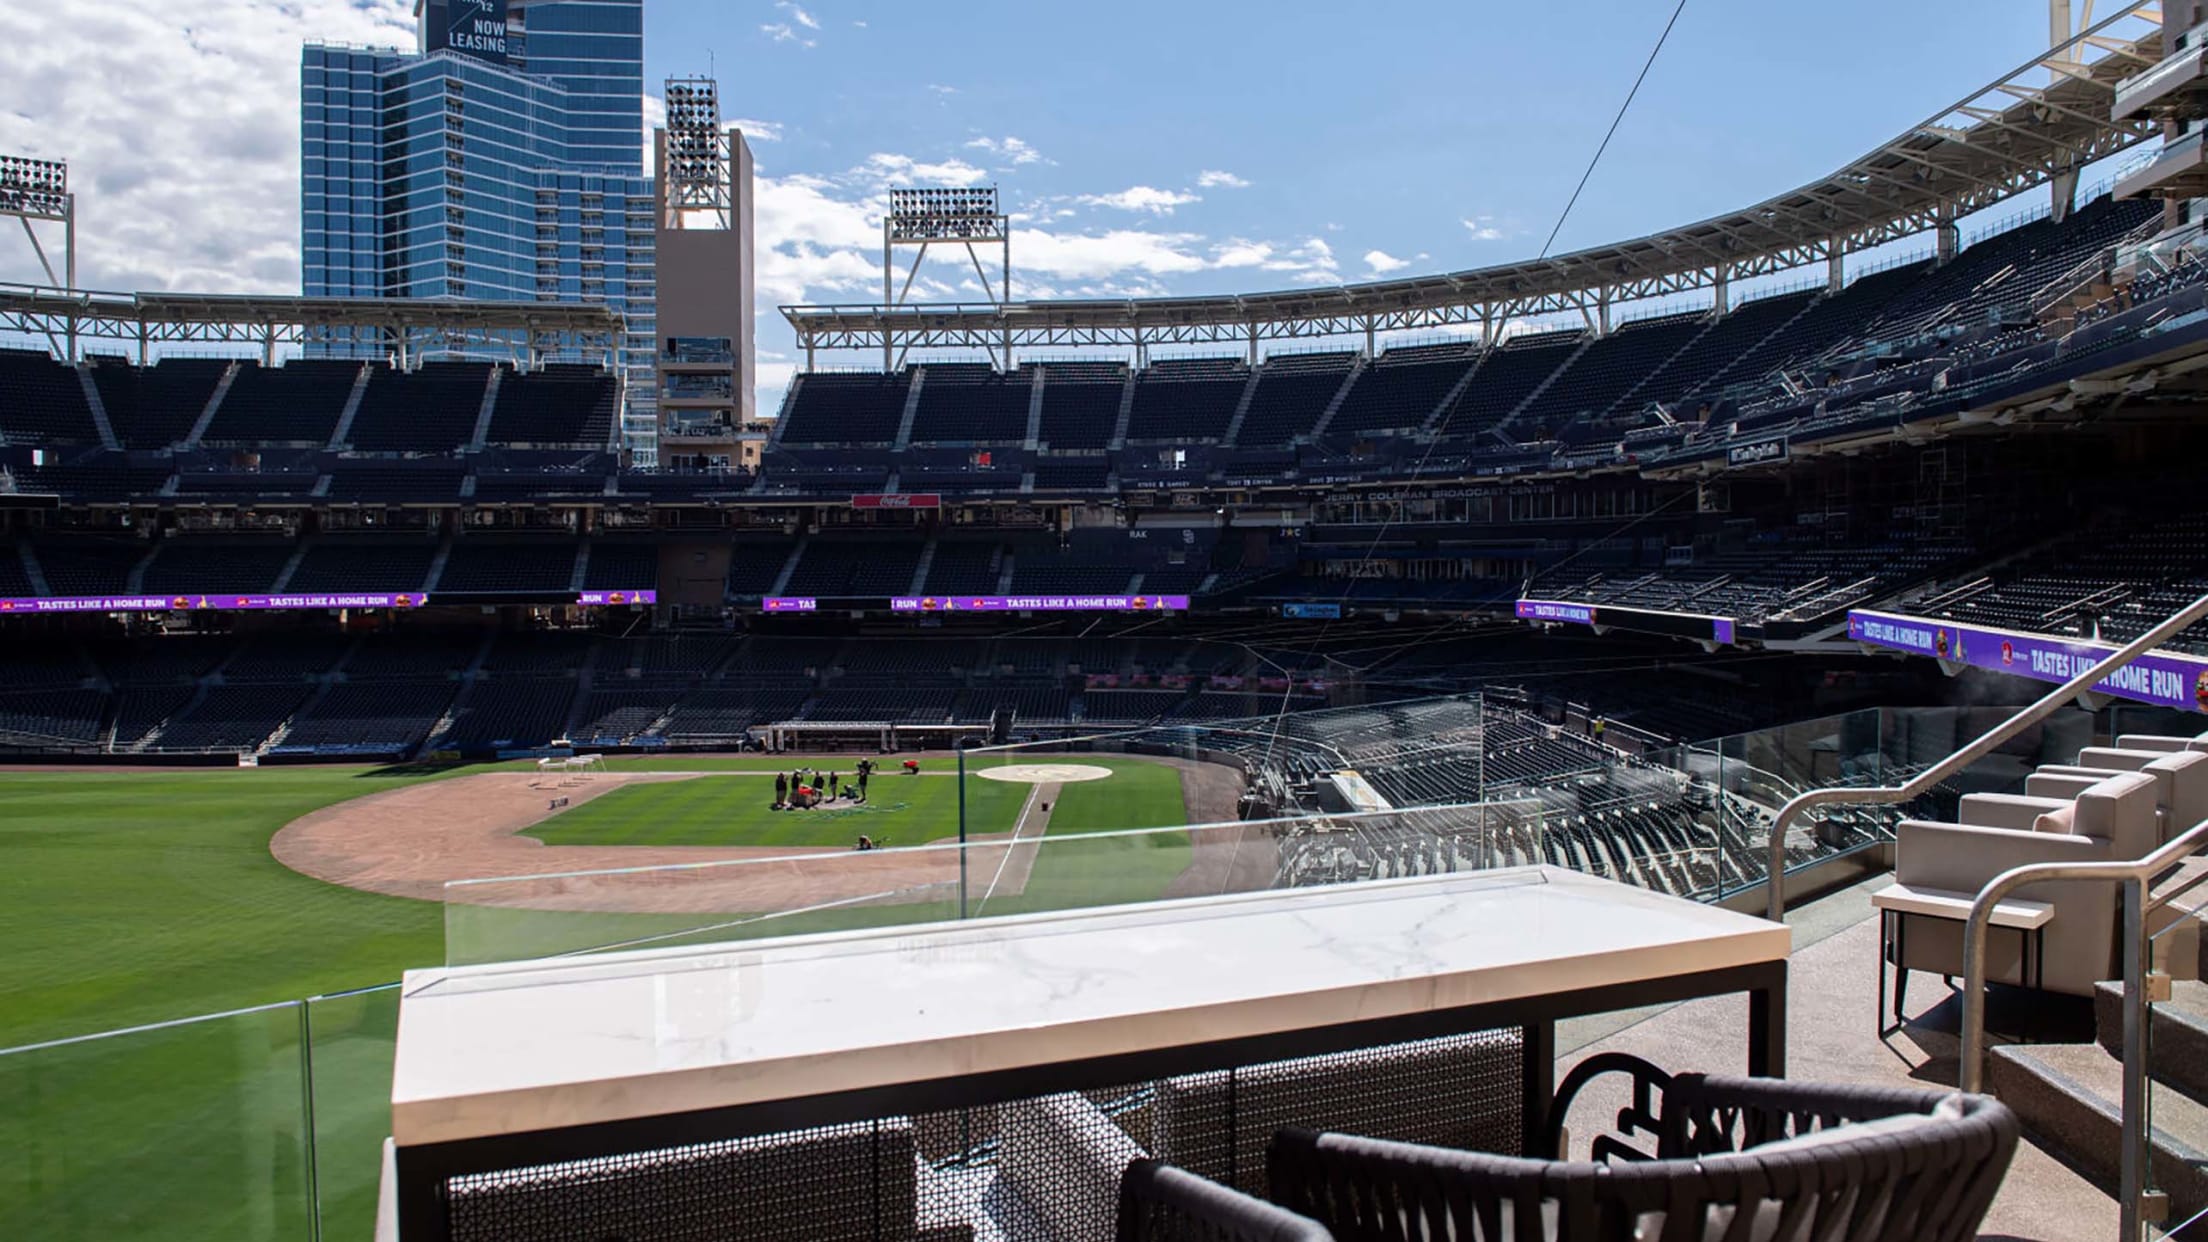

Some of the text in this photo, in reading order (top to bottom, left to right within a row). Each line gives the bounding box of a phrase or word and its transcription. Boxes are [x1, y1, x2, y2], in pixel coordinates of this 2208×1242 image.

[474, 19, 505, 36] NOW
[449, 32, 506, 52] LEASING
[1324, 484, 1555, 502] JERRY COLEMAN BROADCAST CENTER
[37, 600, 76, 610] TASTES
[78, 600, 101, 609] LIKE
[104, 600, 112, 608] A
[113, 599, 144, 608] HOME
[145, 598, 166, 608] RUN
[269, 598, 304, 606] TASTES
[306, 598, 328, 606] LIKE
[329, 598, 336, 606] A
[338, 597, 366, 605] HOME
[368, 596, 388, 604] RUN
[582, 594, 602, 602] RUN
[896, 600, 917, 608] RUN
[1006, 599, 1041, 608] TASTES
[1042, 599, 1065, 608] LIKE
[1066, 599, 1075, 607] A
[1076, 598, 1105, 607] HOME
[1106, 598, 1127, 606] RUN
[1864, 620, 1882, 638] TASTES
[1882, 624, 1894, 642] LIKE
[1900, 628, 1918, 646] HOME
[1918, 630, 1932, 649] RUN
[2032, 649, 2070, 677] TASTES
[2110, 664, 2150, 694] HOME
[2152, 670, 2184, 700] RUN
